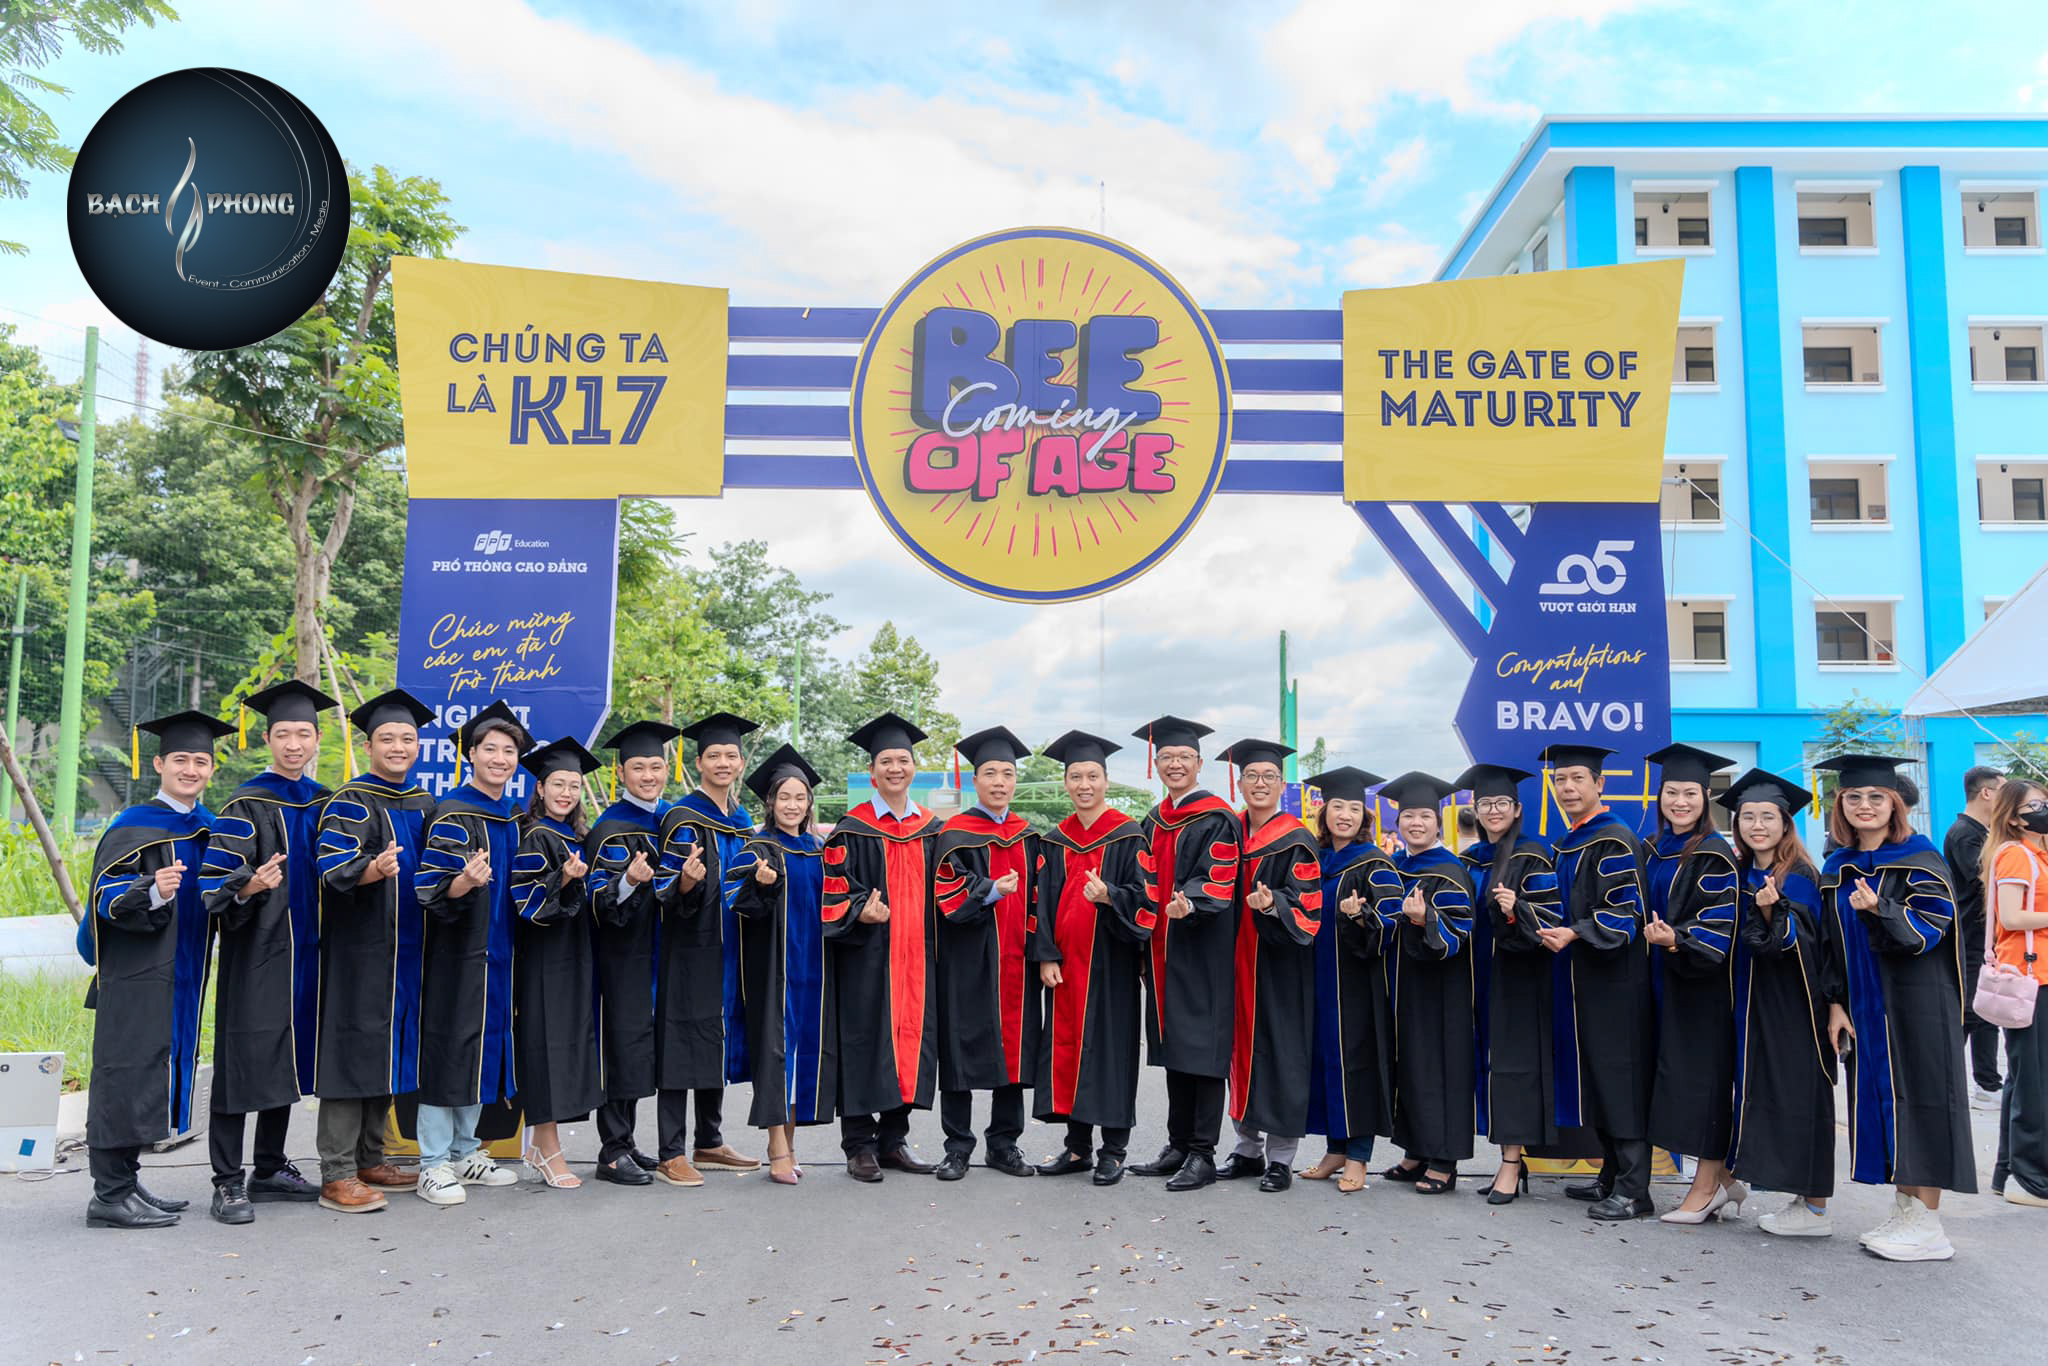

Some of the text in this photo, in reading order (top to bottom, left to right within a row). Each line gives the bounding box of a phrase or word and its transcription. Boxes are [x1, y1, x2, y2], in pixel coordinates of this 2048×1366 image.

[449, 324, 669, 363] CHÚNG TA
[910, 306, 1162, 430] BEE
[1378, 350, 1637, 380] THE GATE OF
[447, 373, 668, 445] LÀ K17
[942, 382, 1137, 461] Coming
[1380, 390, 1641, 427] MATURITY
[904, 426, 1176, 502] OF AGE
[473, 530, 550, 554] FPT Education
[515, 561, 545, 573] CAO
[1609, 603, 1637, 615] HẠN
[423, 630, 546, 669] các em đã
[429, 613, 500, 649] Chúc
[447, 653, 561, 701] trở thành
[1496, 642, 1647, 684] Congratulations
[1549, 667, 1589, 694] and
[1497, 701, 1644, 732] BRAVO!
